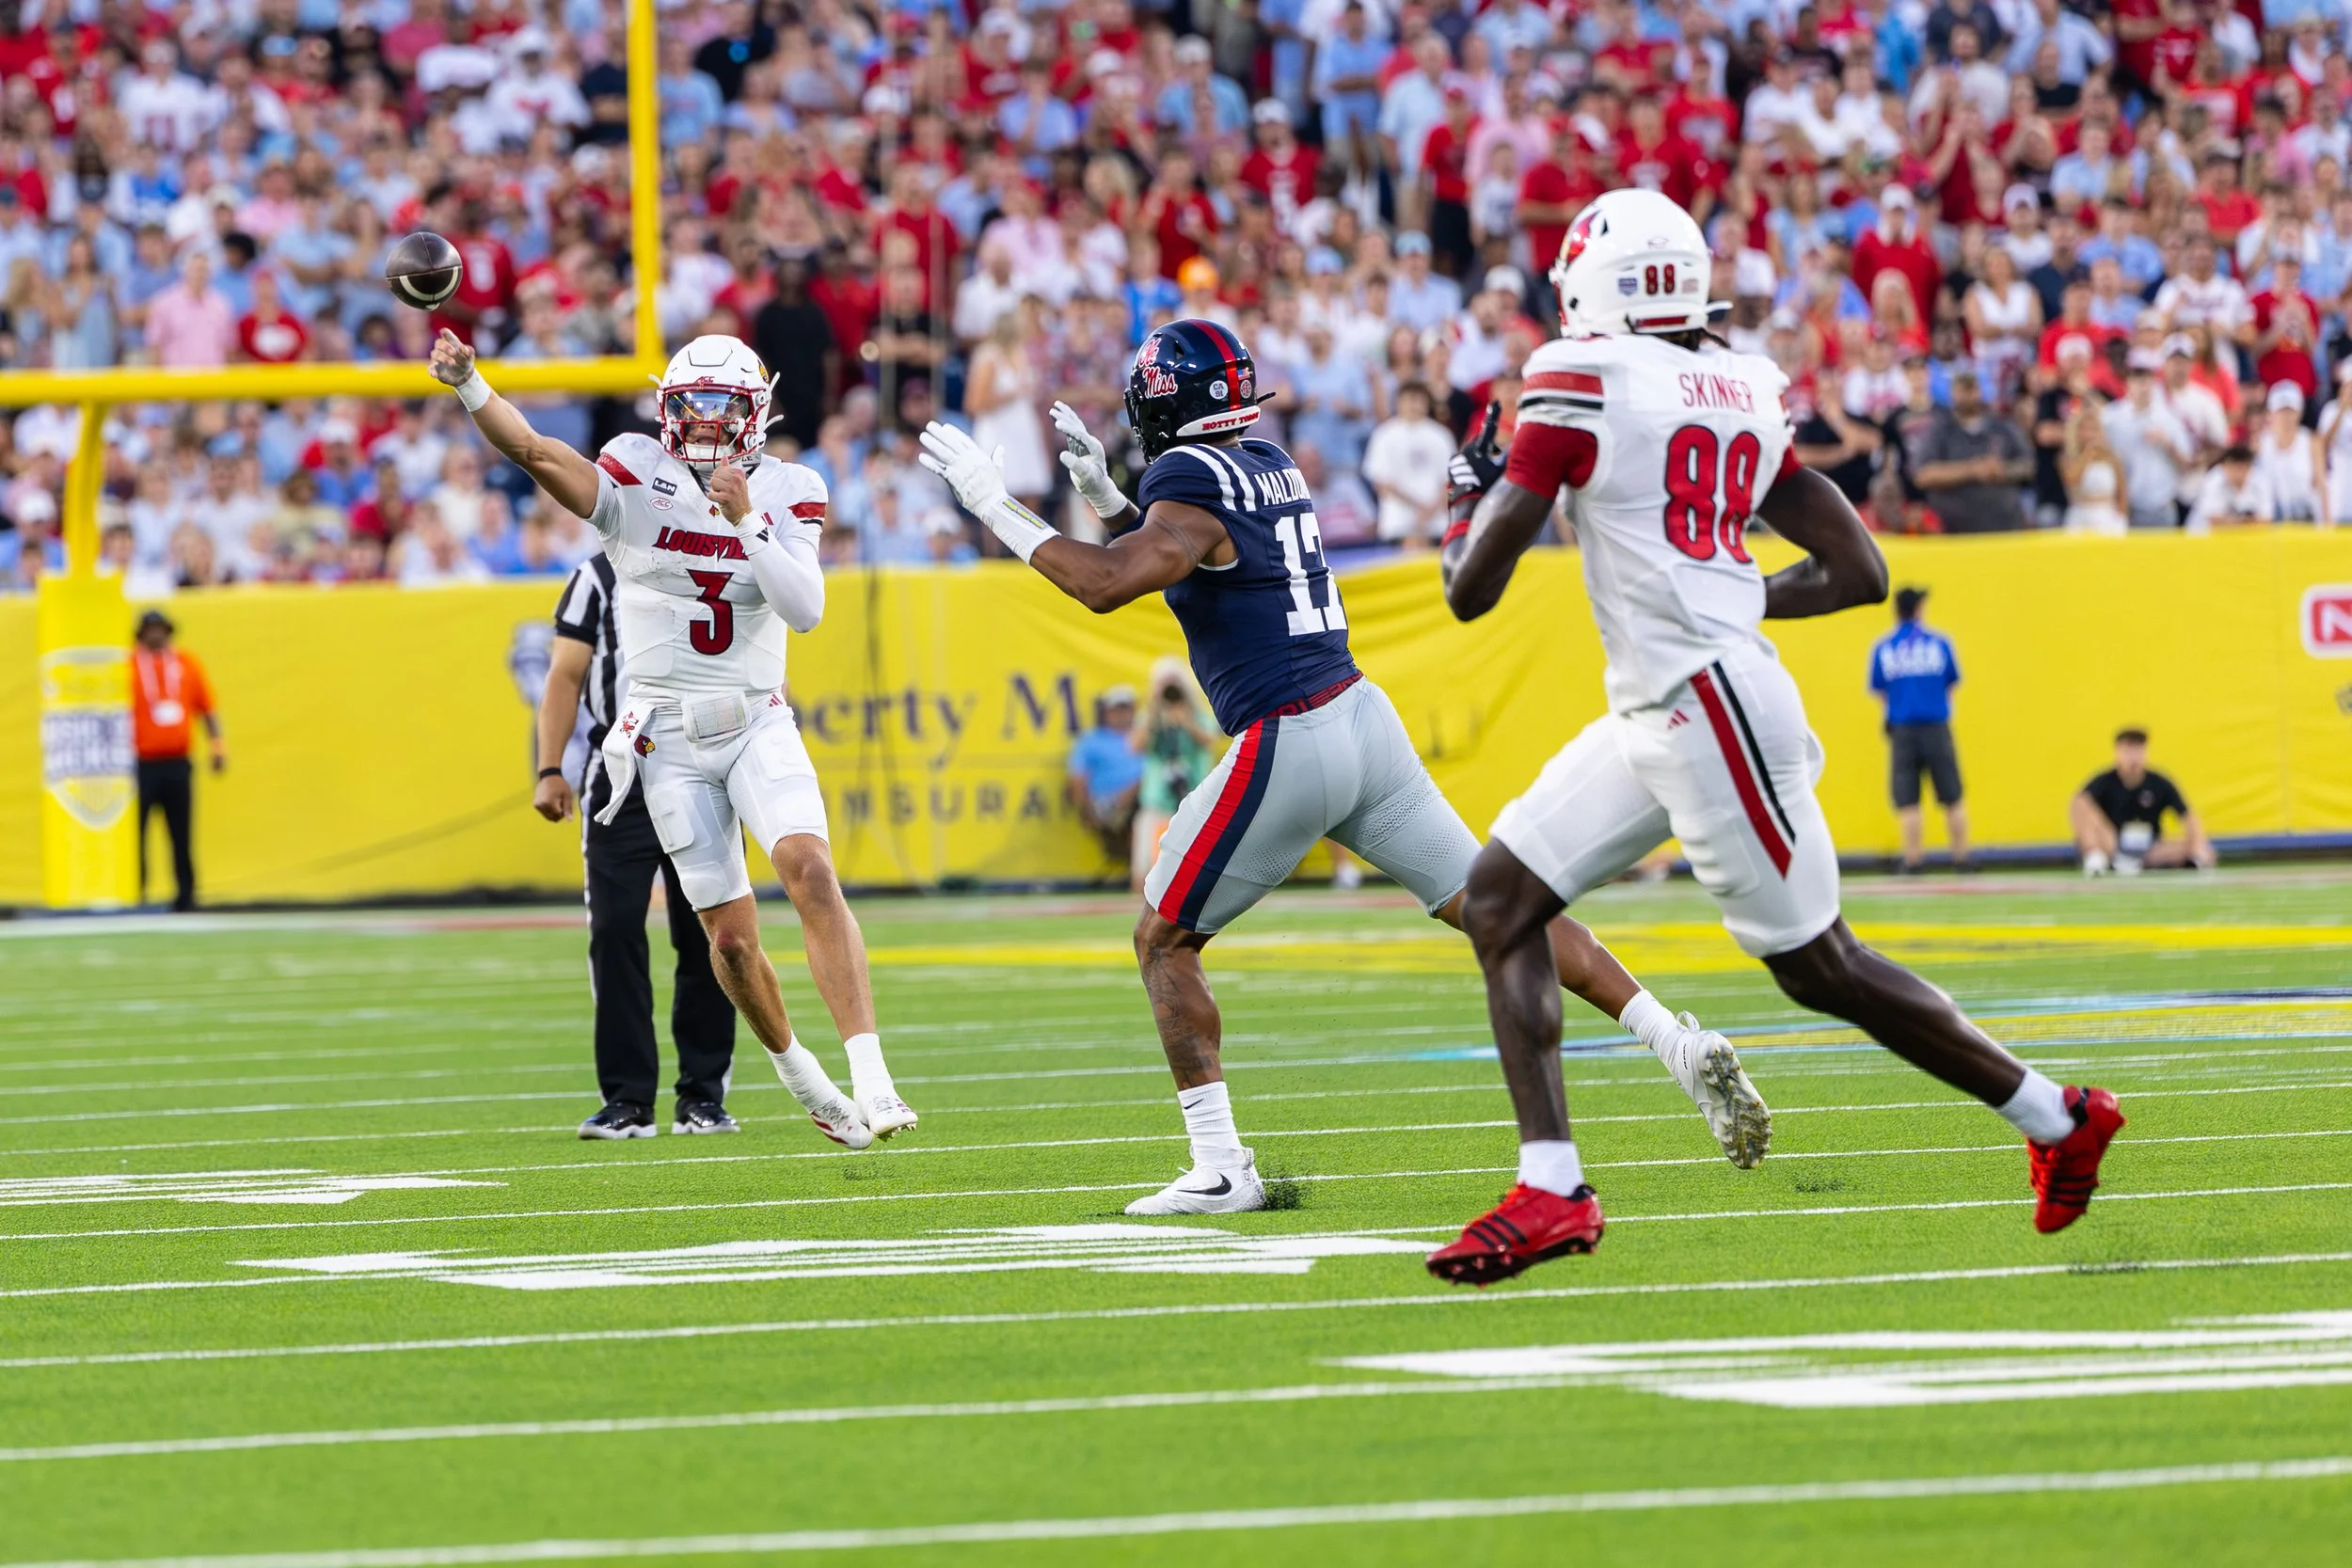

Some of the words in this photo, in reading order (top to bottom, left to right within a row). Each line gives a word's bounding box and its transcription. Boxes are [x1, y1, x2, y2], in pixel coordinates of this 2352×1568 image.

[1645, 263, 1676, 295] 88
[1138, 338, 1162, 368] Ole
[1142, 367, 1179, 399] Miss
[1678, 372, 1756, 415] SKINNER
[1201, 417, 1237, 431] HOTTY
[653, 499, 671, 508] ACC
[1663, 424, 1761, 564] 88
[651, 525, 750, 562] LOUISVIL
[687, 568, 734, 656] 3
